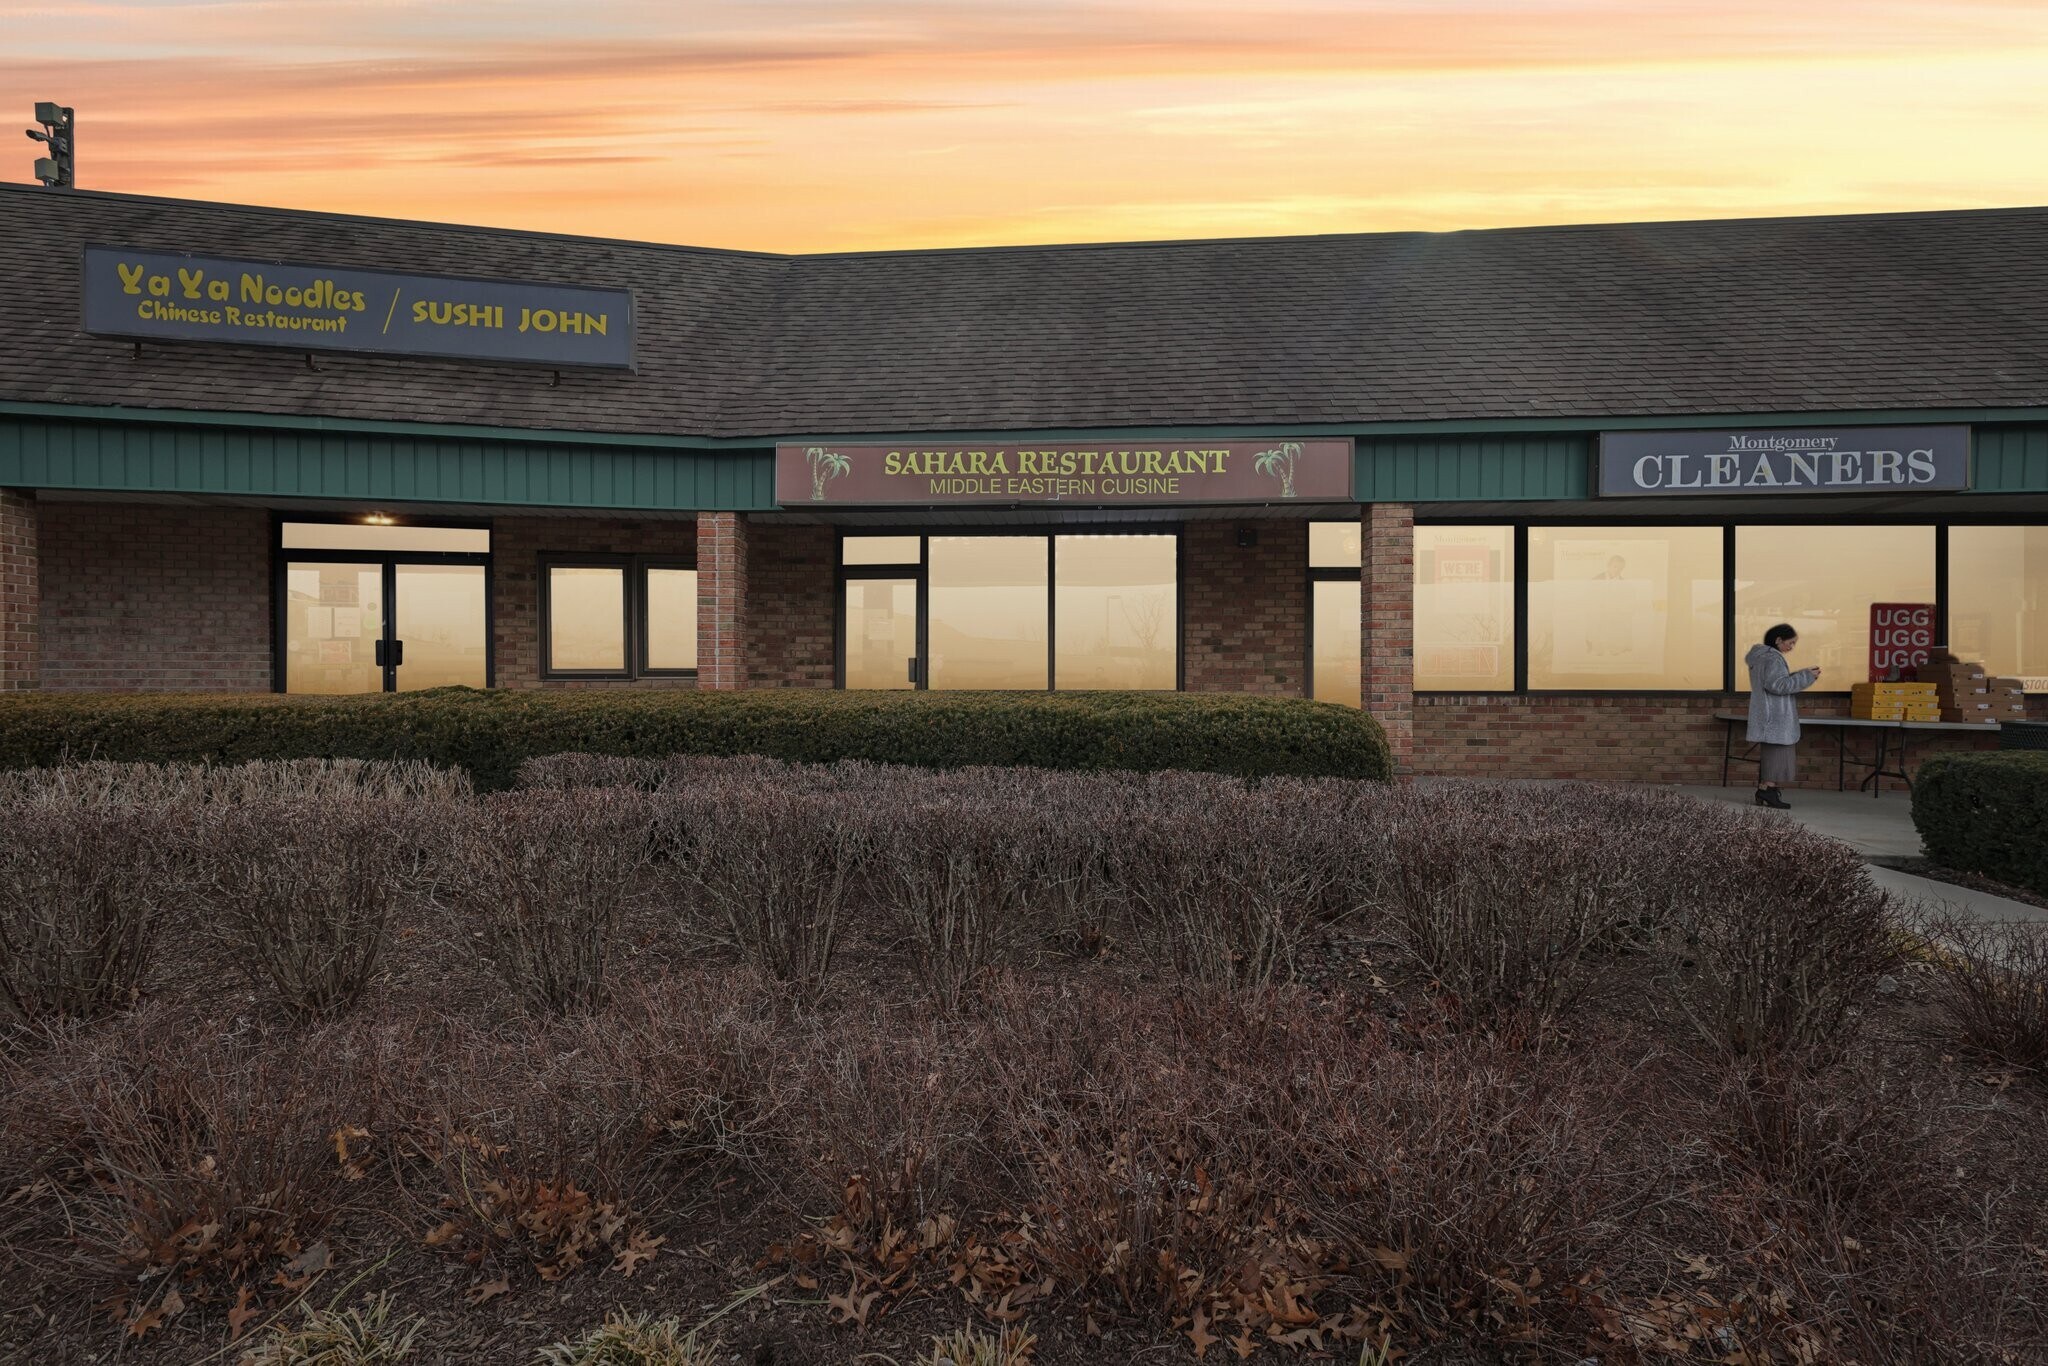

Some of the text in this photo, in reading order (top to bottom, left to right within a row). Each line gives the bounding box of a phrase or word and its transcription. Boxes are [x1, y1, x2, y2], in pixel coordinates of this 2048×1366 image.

[117, 263, 366, 312] Ya Ya Noodles
[137, 299, 347, 333] Chinese Restaurant
[412, 300, 503, 328] SUSHI
[518, 308, 607, 336] JOHN
[1729, 435, 1838, 452] Montgomery
[885, 449, 1230, 475] SAHARA RESTAURANT
[1633, 448, 1936, 489] CLEANERS
[930, 478, 1179, 495] MIDDLE EASTERN CUISINE
[1876, 609, 1929, 626] UGG
[1874, 629, 1930, 647] UGG
[1874, 649, 1929, 669] UGG
